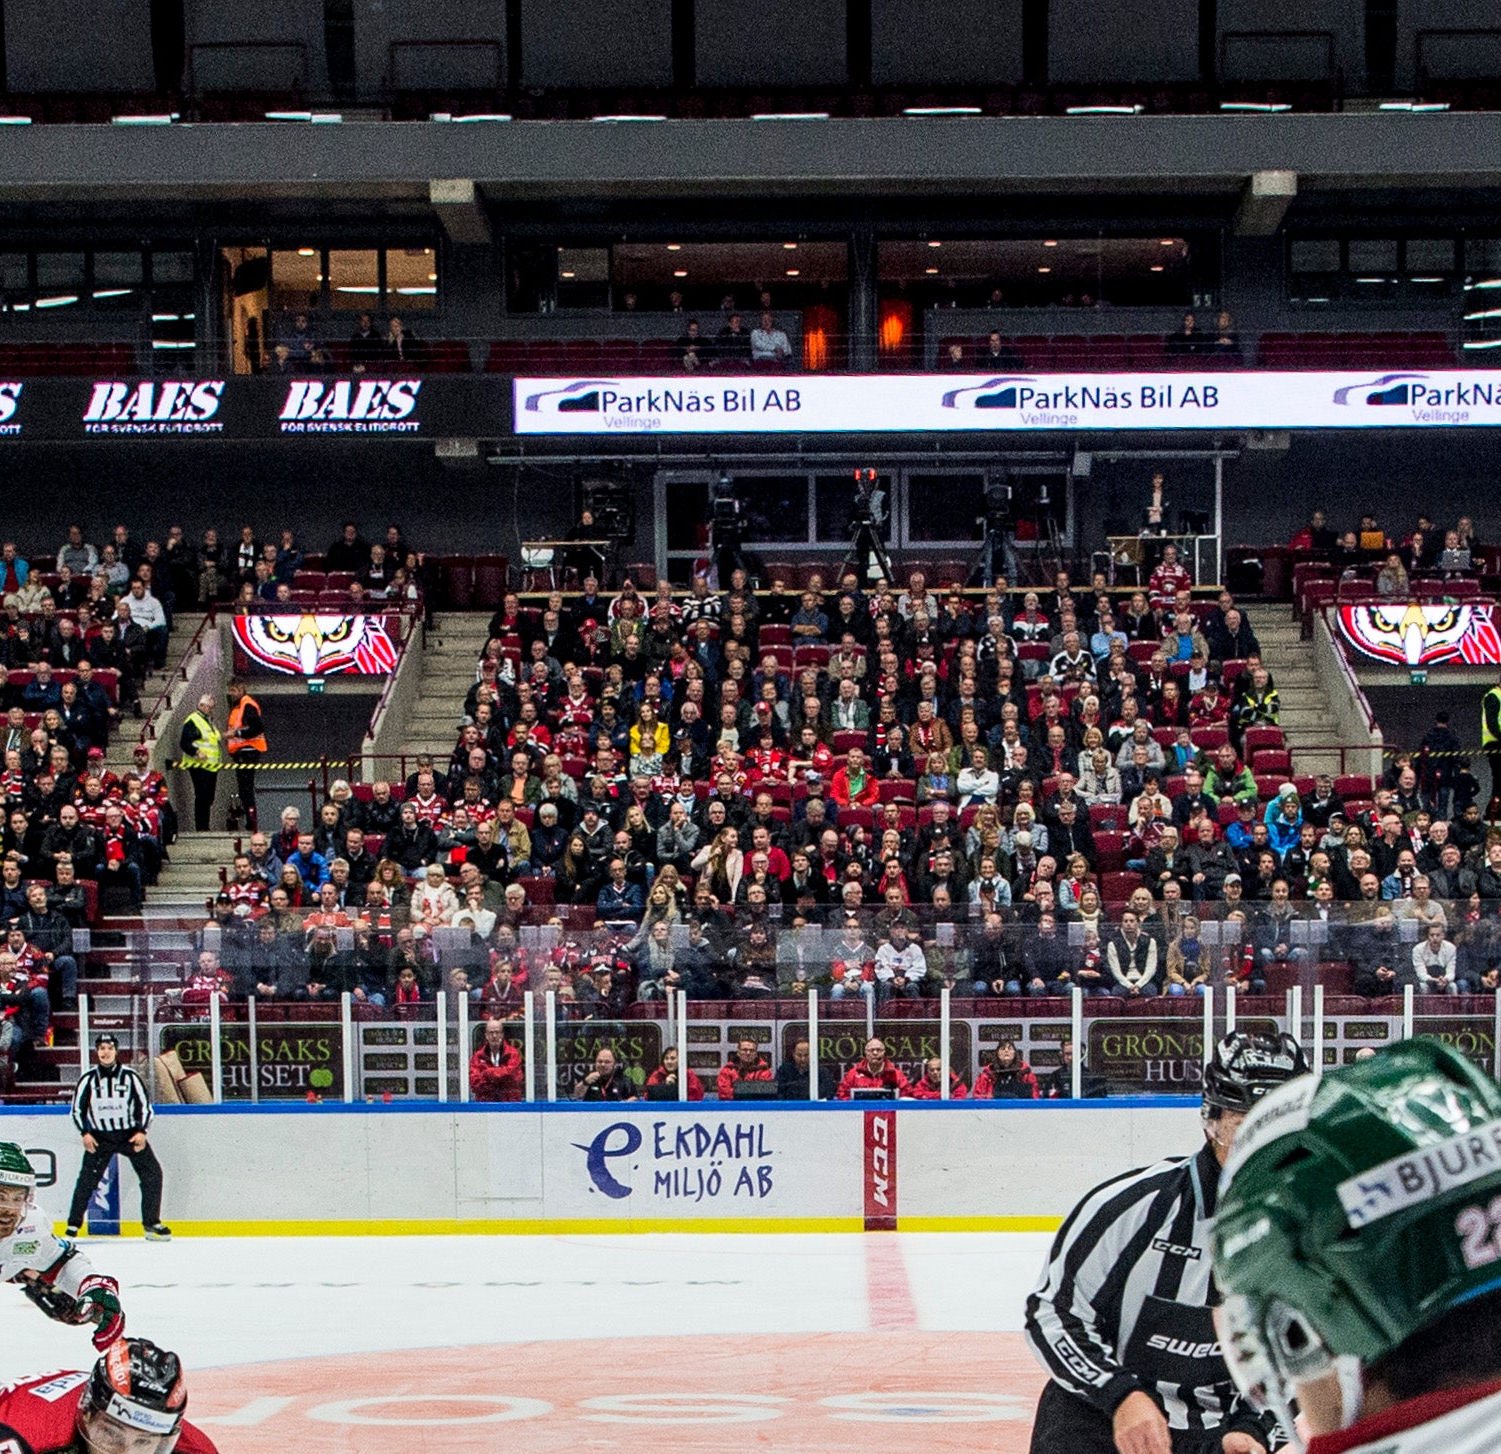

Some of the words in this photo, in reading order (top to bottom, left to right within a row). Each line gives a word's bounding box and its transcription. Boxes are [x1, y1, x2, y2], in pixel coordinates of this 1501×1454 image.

[601, 389, 716, 414] ParkNäs
[723, 388, 756, 413] Bil
[762, 389, 801, 412] AB
[1019, 386, 1133, 411] ParkNäs
[1140, 385, 1172, 409] Bil
[1179, 387, 1219, 409] AB
[603, 415, 661, 430] Vellinge
[1021, 411, 1078, 426] Vellinge
[1412, 408, 1470, 423] Vellinge
[1102, 1025, 1202, 1058] GRÖNS
[1146, 1060, 1201, 1083] HUS
[653, 1122, 774, 1159] EKDAHL
[871, 1116, 890, 1207] CCM
[653, 1160, 722, 1202] MILJÖ
[735, 1165, 774, 1197] AB
[1153, 1240, 1201, 1259] CCM
[1056, 1337, 1100, 1383] CCM
